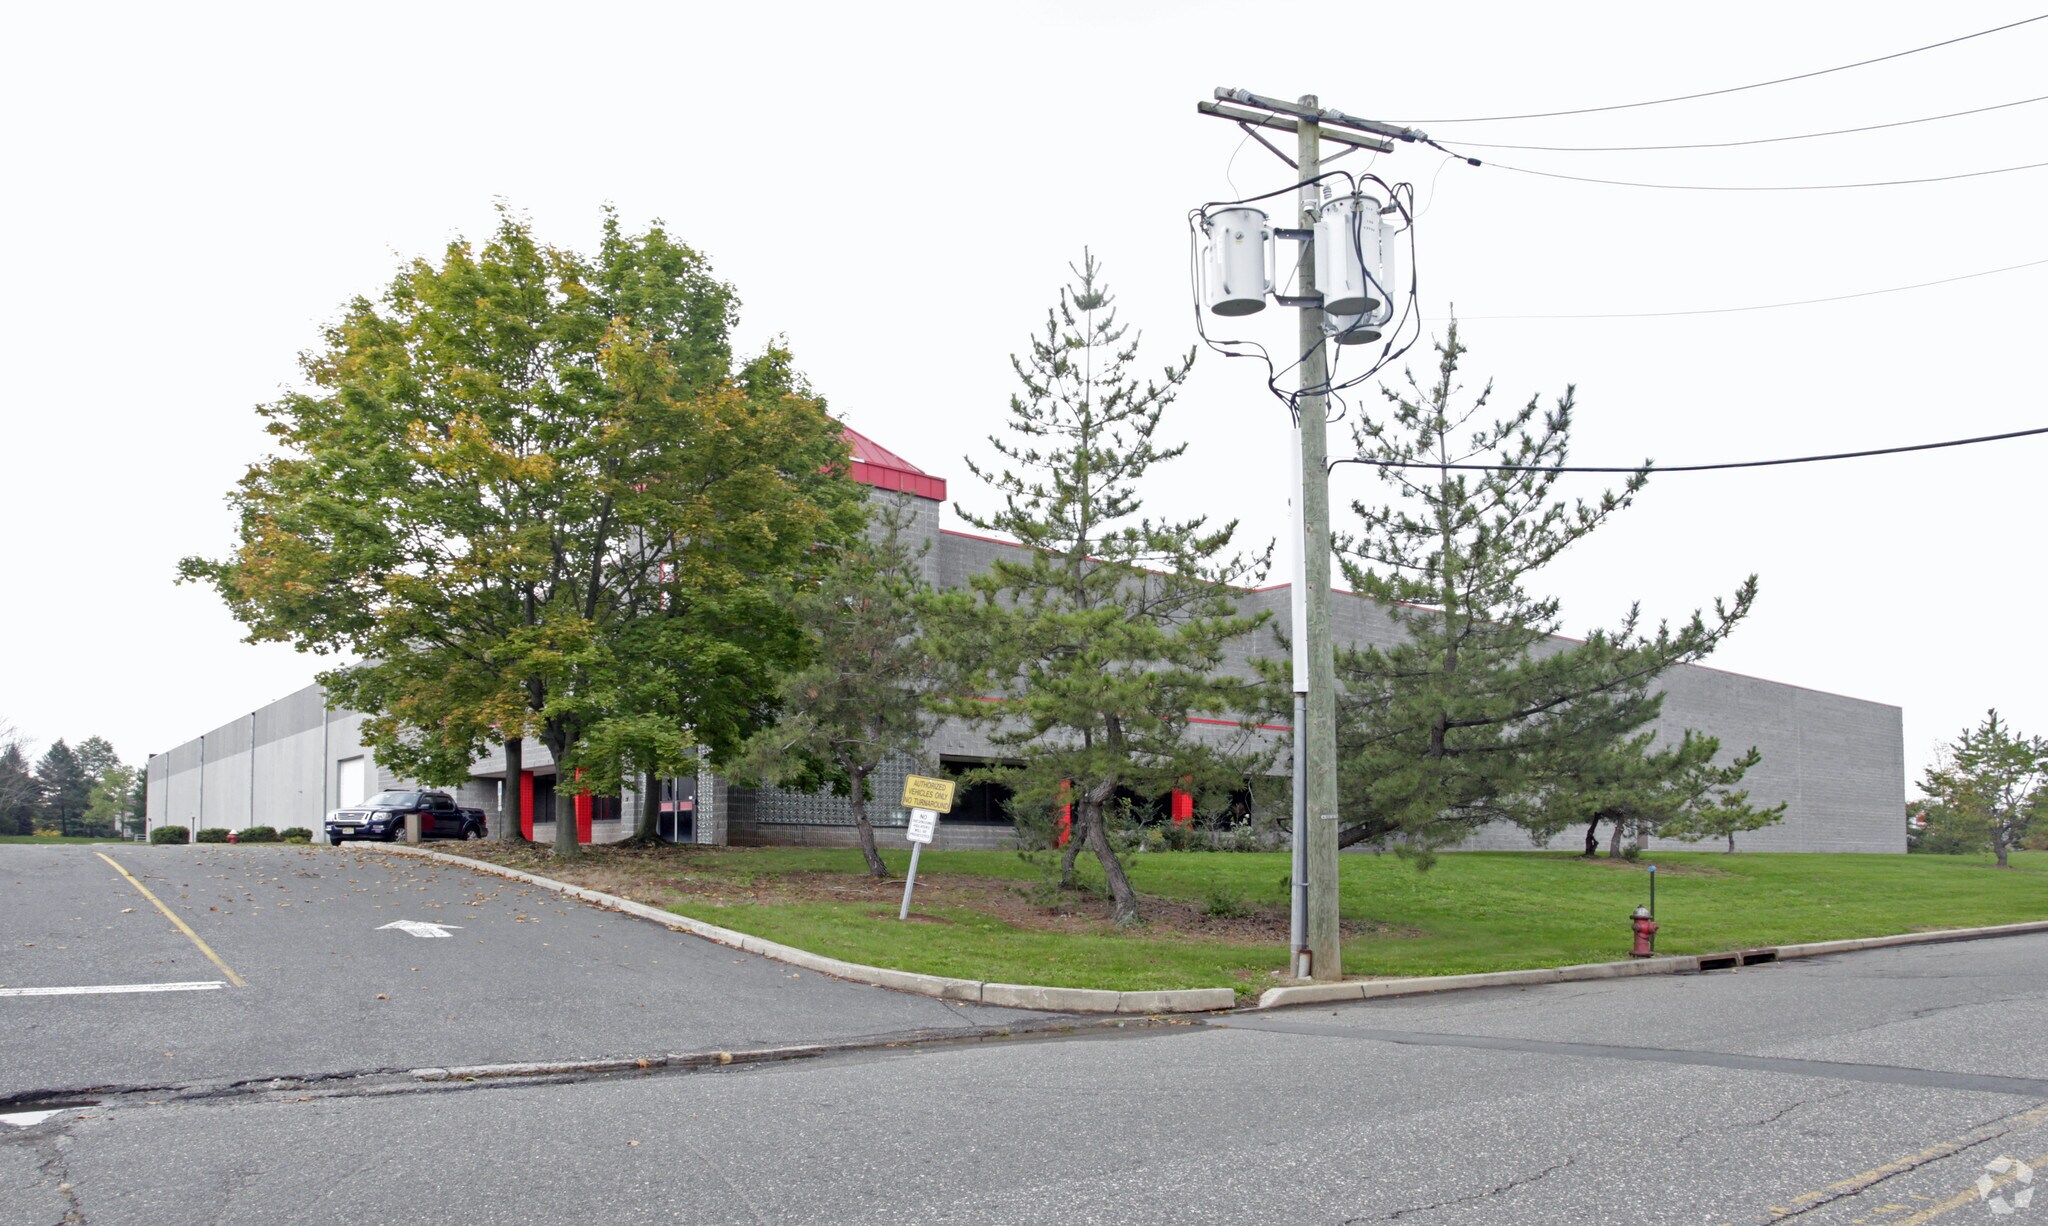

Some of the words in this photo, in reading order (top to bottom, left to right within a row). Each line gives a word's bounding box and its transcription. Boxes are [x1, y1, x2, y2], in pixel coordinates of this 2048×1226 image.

[914, 780, 946, 791] AUTHORIZED
[909, 788, 933, 798] VEHICLES
[935, 792, 949, 800] ONLY
[905, 796, 912, 804] NO
[914, 798, 949, 809] TURNAROUND
